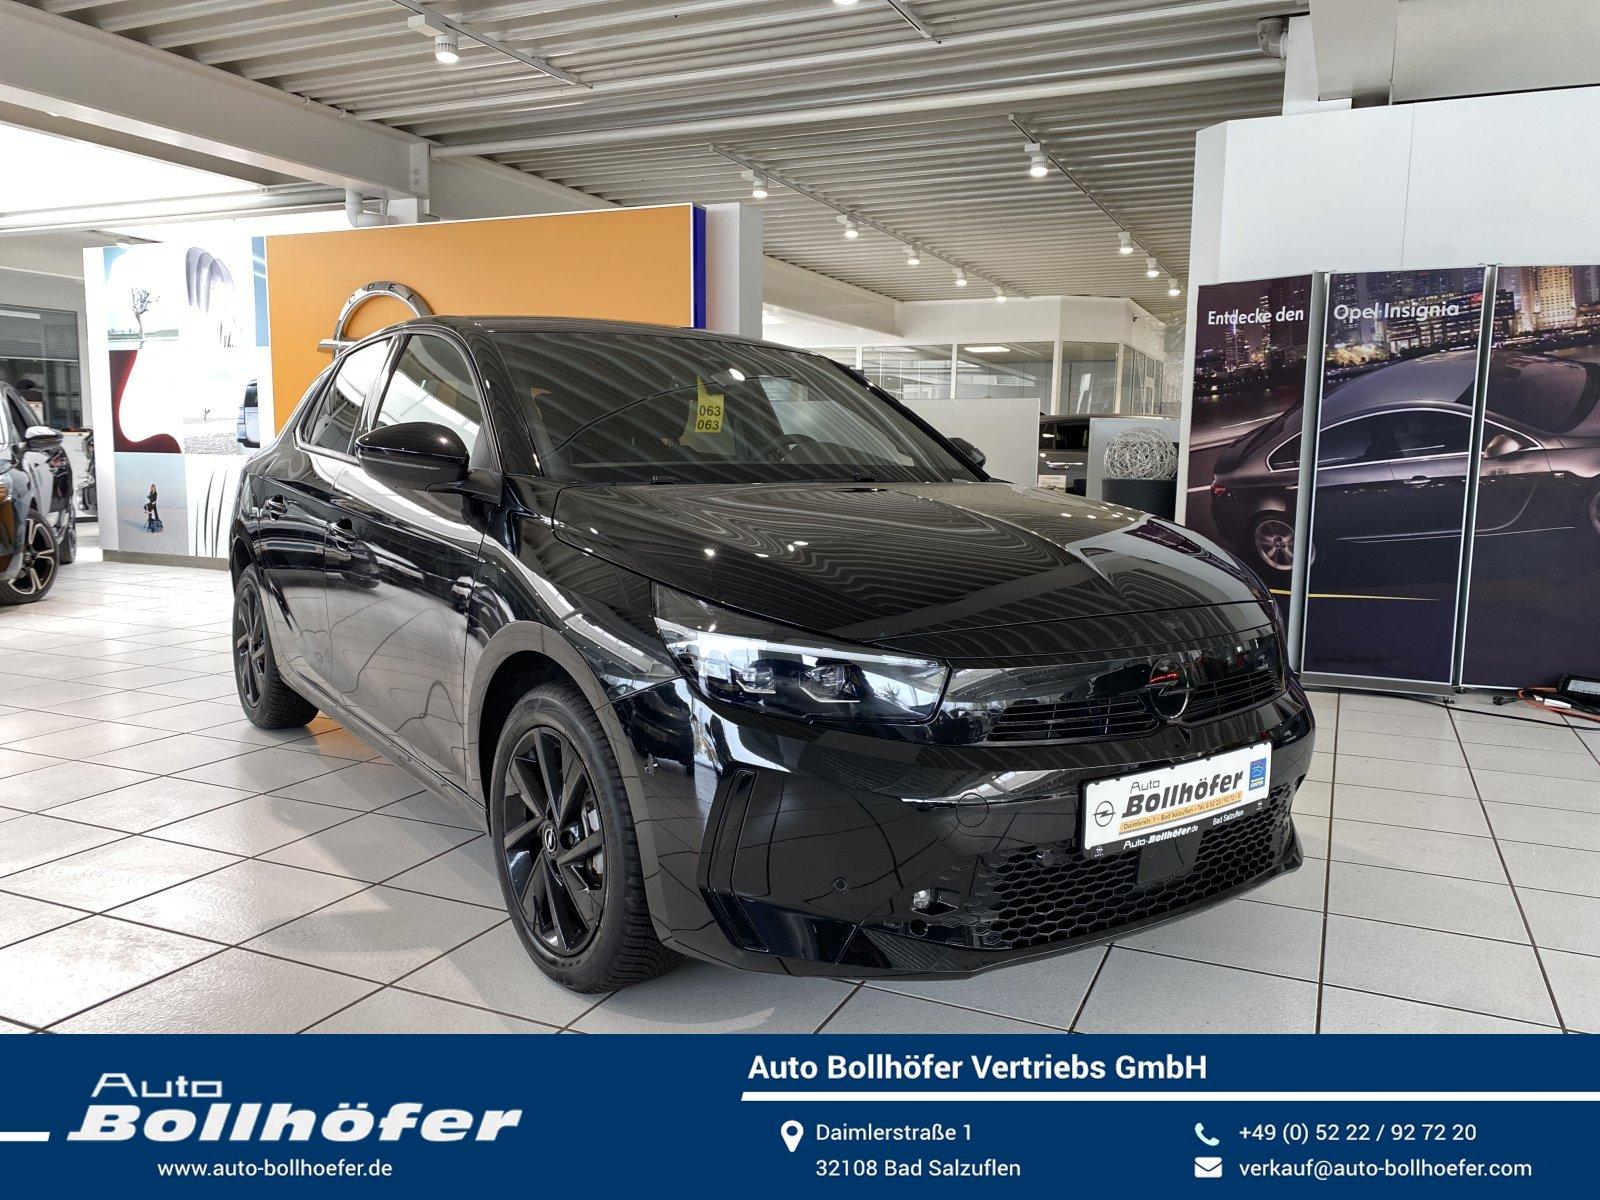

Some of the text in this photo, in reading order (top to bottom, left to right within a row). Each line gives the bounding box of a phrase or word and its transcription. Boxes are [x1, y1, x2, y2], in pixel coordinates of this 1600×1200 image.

[1207, 300, 1460, 325] Entdecke den Opel Insignia
[699, 405, 721, 417] 063
[697, 419, 719, 431] 063
[1129, 779, 1160, 794] Auto
[1121, 770, 1244, 819] Bollhöfer
[1212, 816, 1223, 826] Bad
[1122, 824, 1199, 850] Auto-Bollhöfer.de
